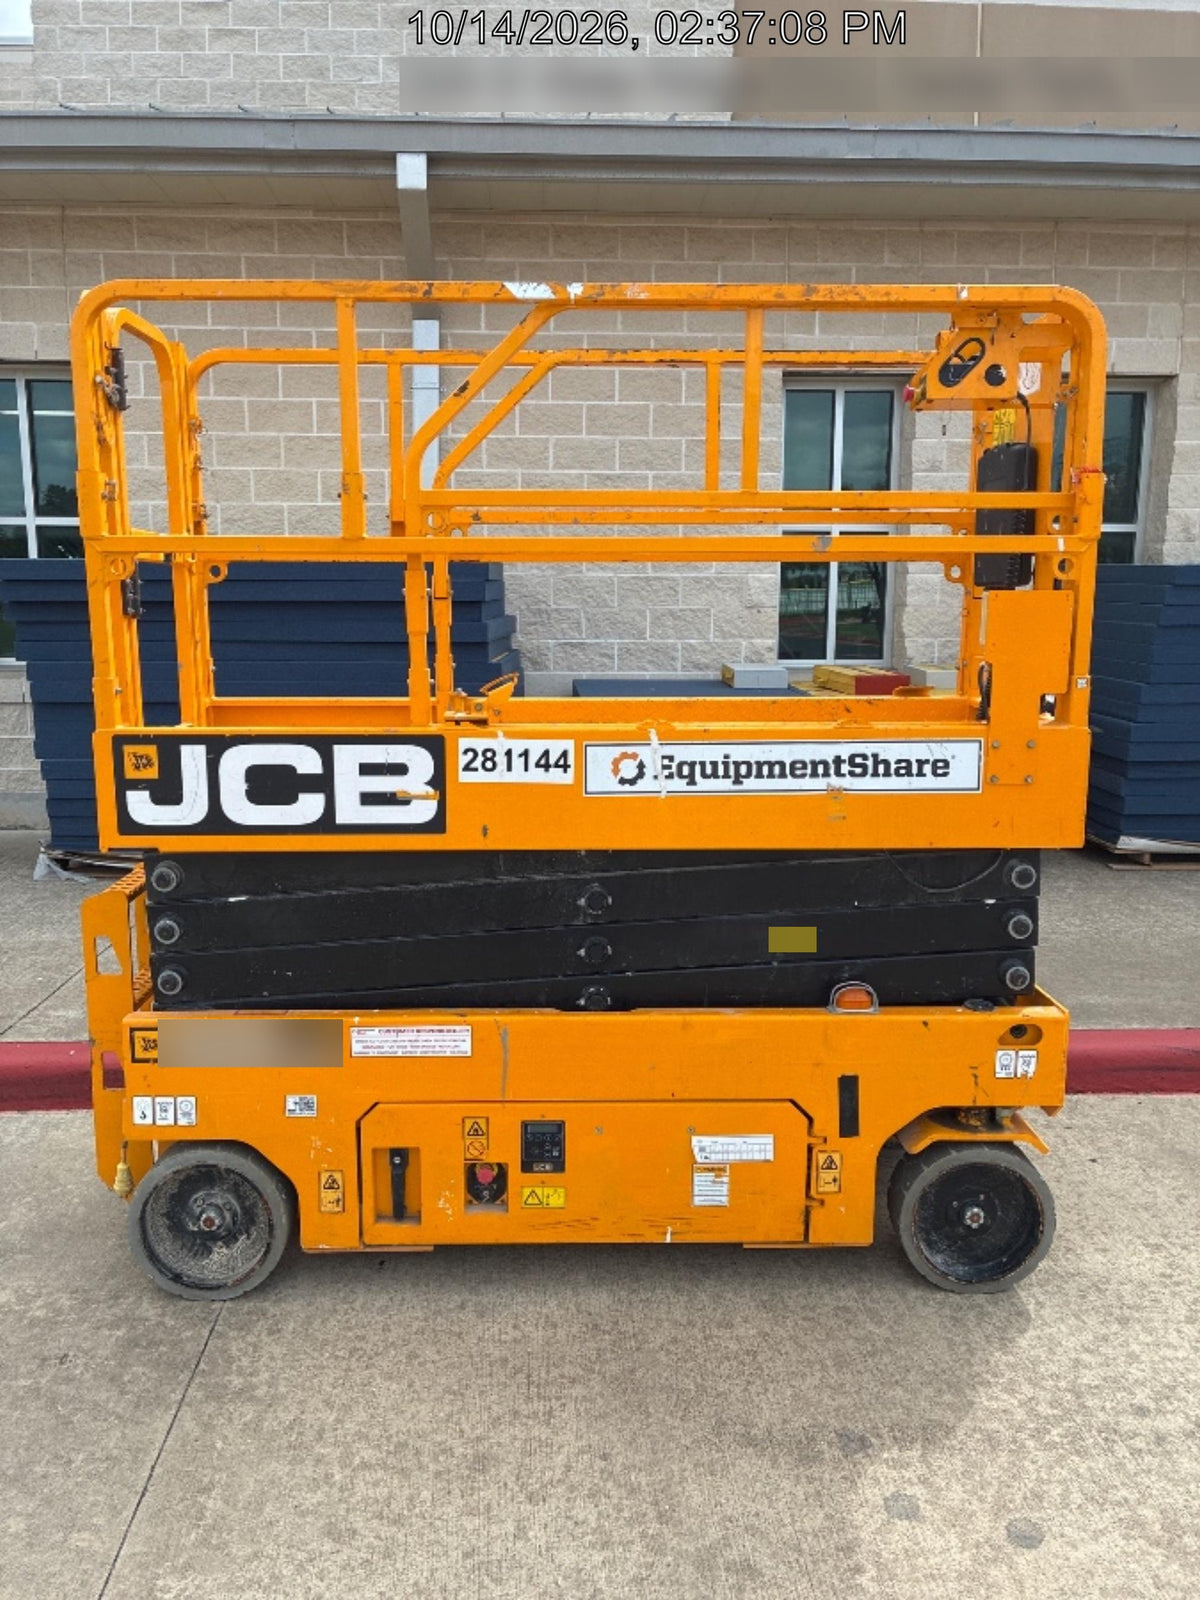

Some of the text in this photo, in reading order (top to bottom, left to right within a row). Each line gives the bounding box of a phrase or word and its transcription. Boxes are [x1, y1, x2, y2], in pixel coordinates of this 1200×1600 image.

[461, 747, 572, 774] 281144
[653, 753, 951, 786] EquipmentShare
[125, 744, 439, 826] JCB
